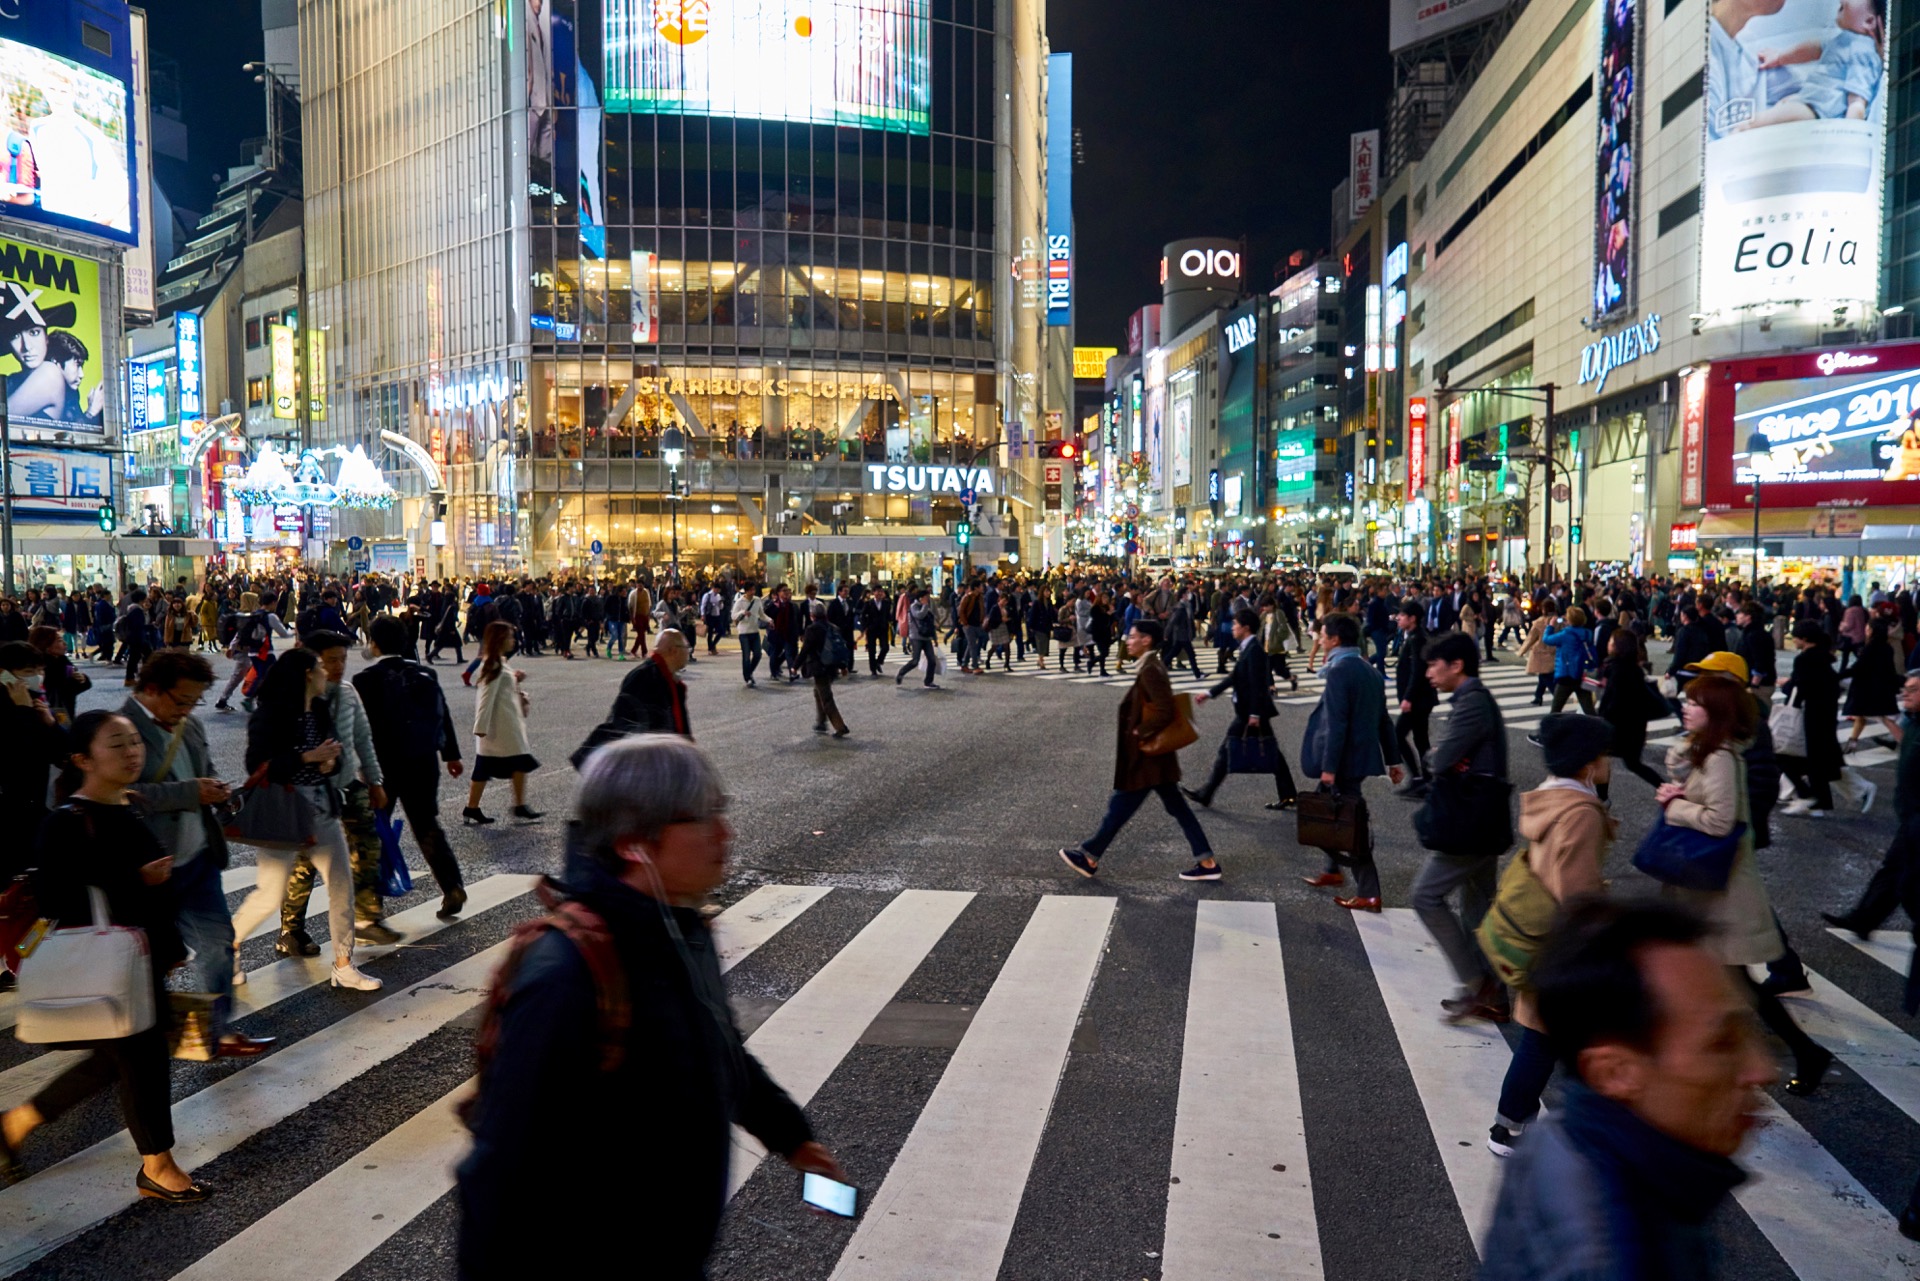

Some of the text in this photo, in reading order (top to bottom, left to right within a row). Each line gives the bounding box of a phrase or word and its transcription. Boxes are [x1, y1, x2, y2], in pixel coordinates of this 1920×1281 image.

[1356, 137, 1373, 199] 大和証券
[1734, 228, 1858, 273] Eolia
[1048, 234, 1070, 309] SEIBU
[0, 280, 47, 327] X
[1224, 313, 1257, 354] ZARA
[1072, 363, 1107, 376] ECORD
[1074, 350, 1104, 362] TOWER
[638, 376, 894, 400] STARBUCKS COFFEE
[1758, 408, 1841, 443] Since
[0, 460, 101, 499] 書店
[867, 464, 994, 493] TSUTAYA
